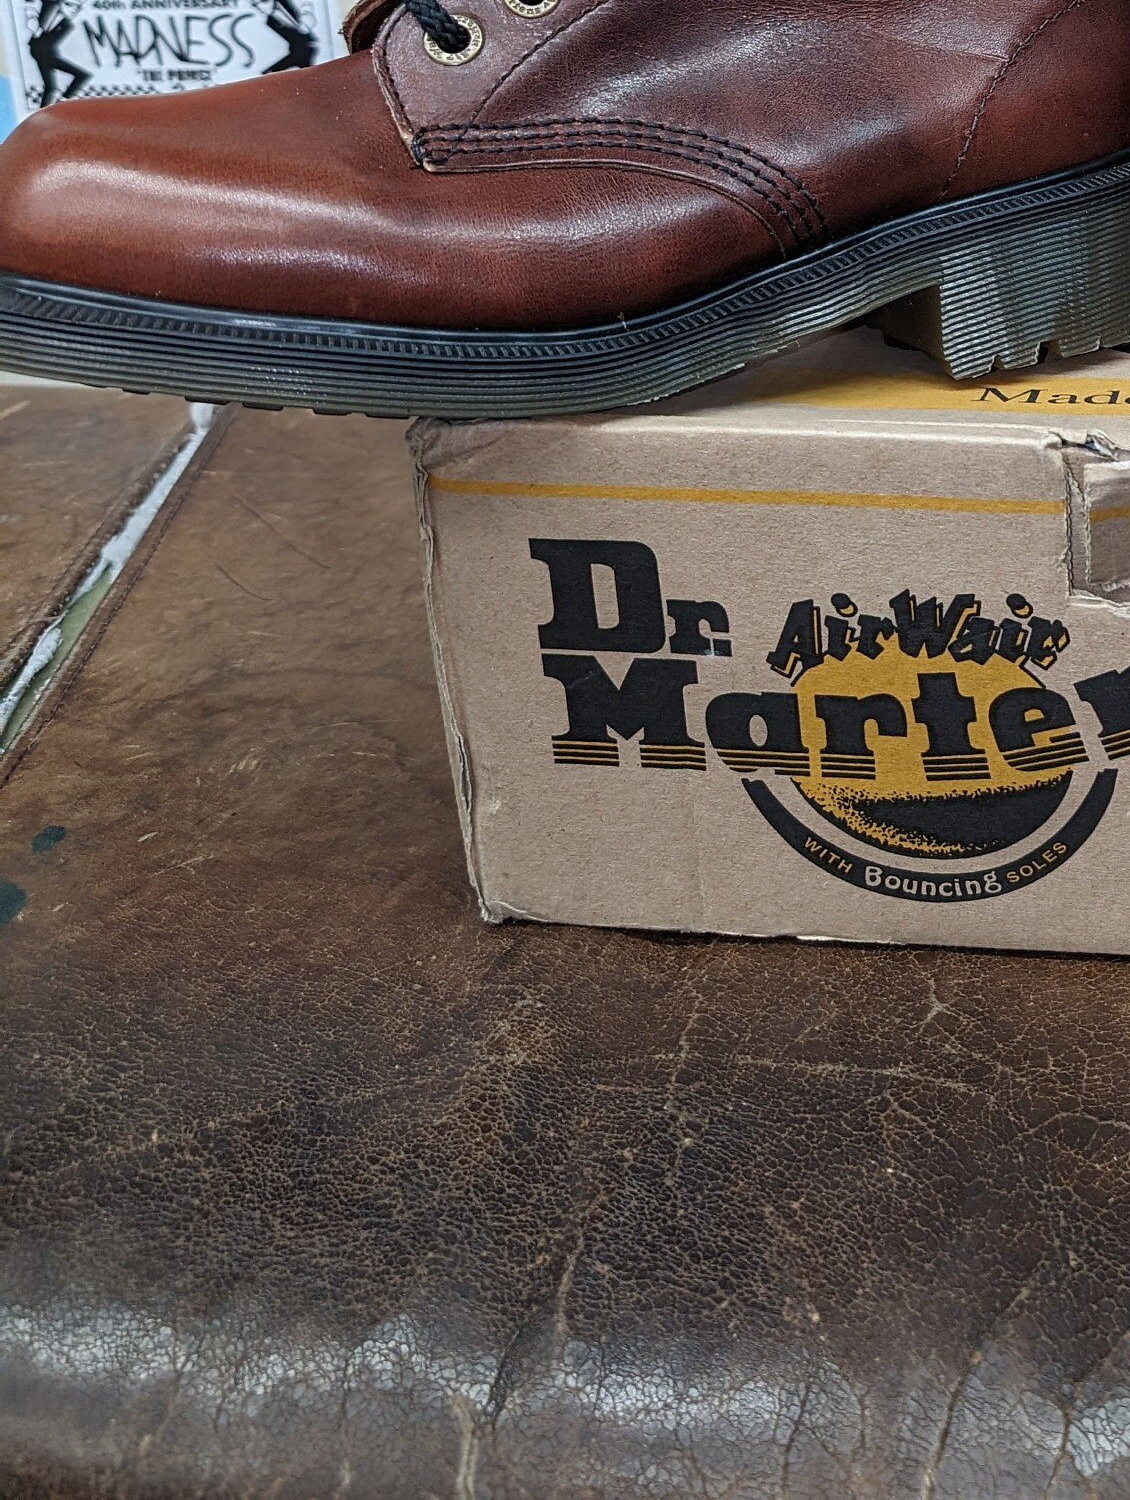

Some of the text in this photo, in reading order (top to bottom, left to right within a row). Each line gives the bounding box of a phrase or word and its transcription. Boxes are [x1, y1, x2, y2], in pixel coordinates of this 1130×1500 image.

[82, 13, 257, 69] MADNESS
[528, 537, 732, 657] Dr
[766, 588, 1071, 678] AirWair
[803, 835, 1069, 898] WITH Bouncing SOLES
